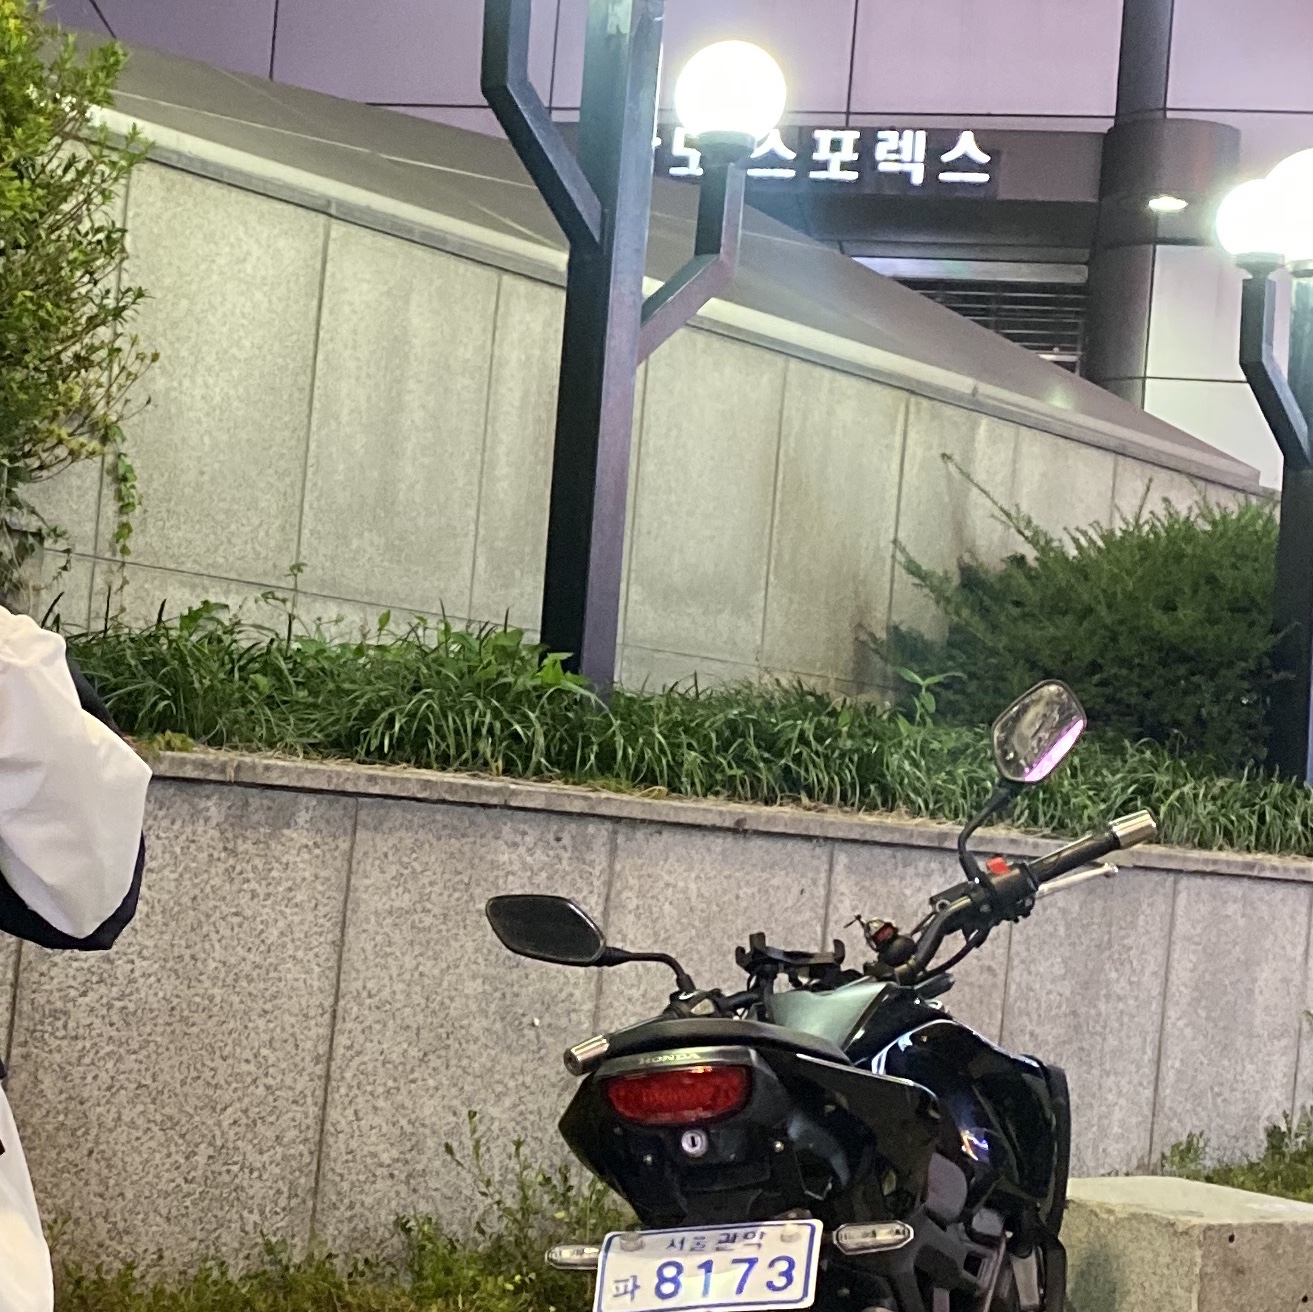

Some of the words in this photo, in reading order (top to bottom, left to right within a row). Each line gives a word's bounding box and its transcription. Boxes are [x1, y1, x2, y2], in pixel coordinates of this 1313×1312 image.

[666, 1236, 706, 1251] 서울
[715, 1231, 766, 1251] 관악
[654, 1255, 796, 1300] 8173
